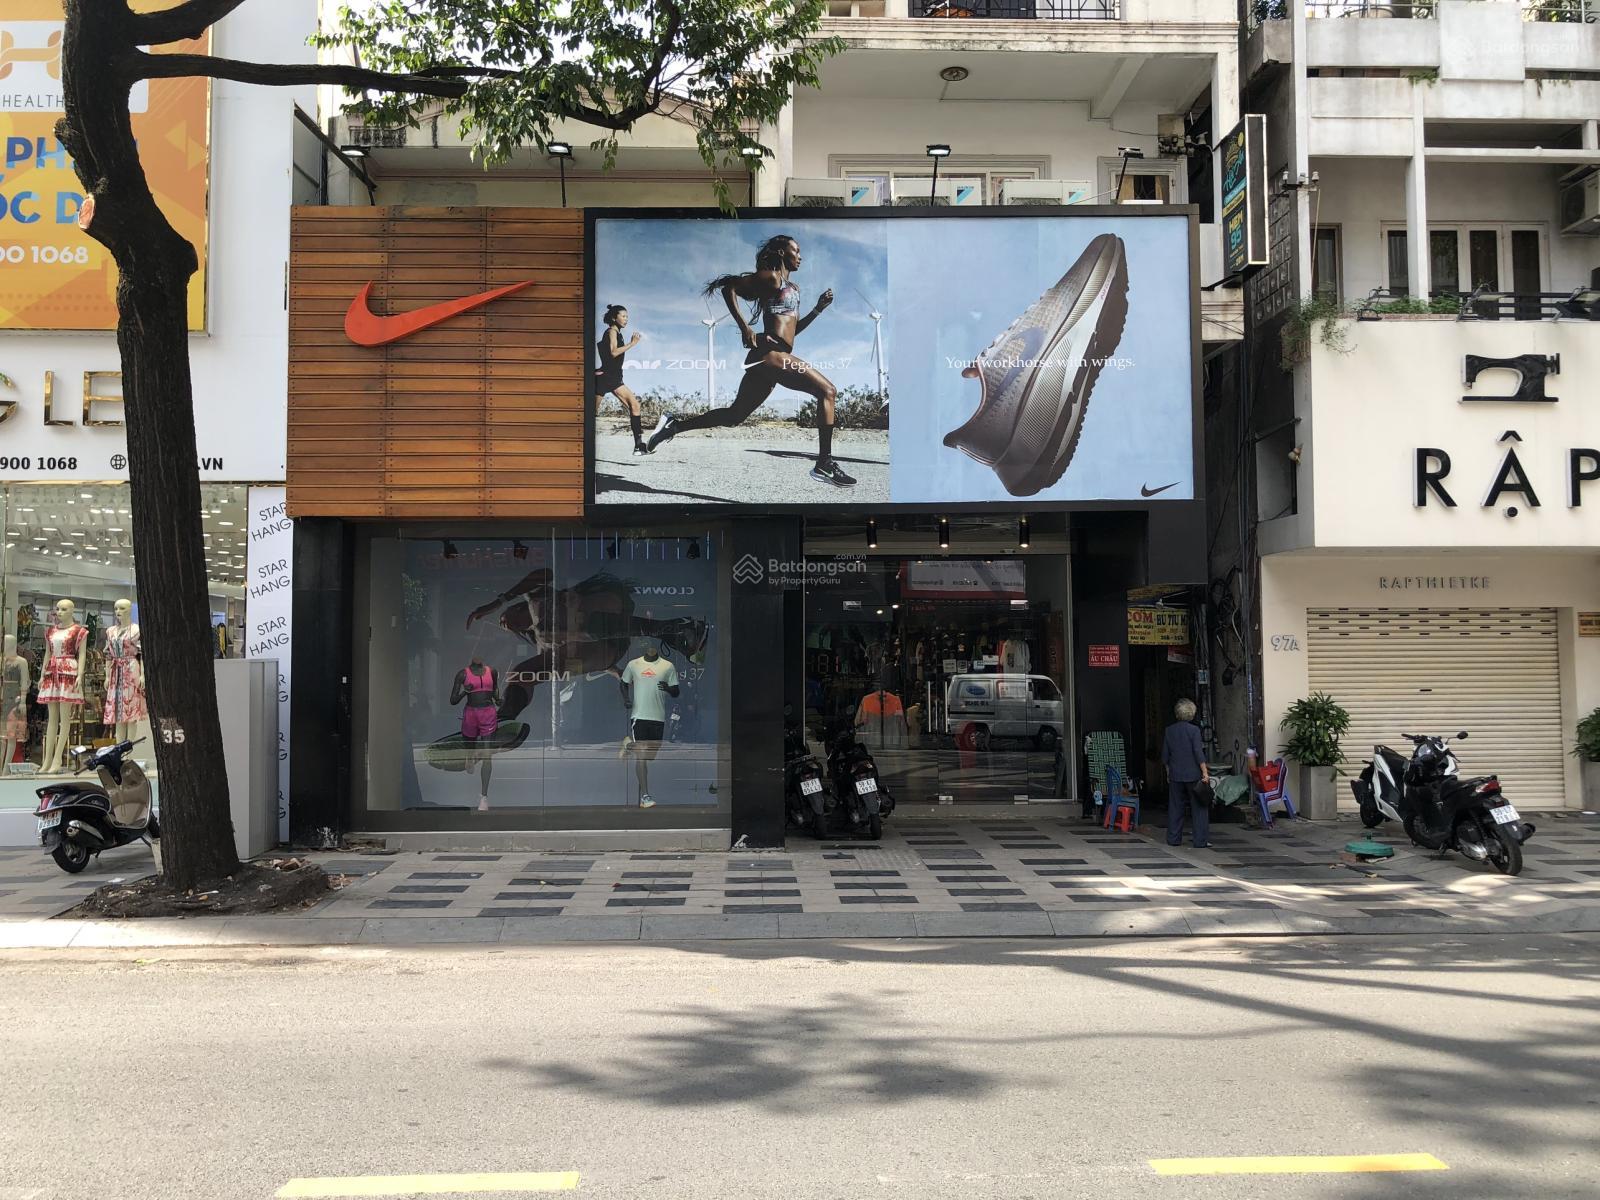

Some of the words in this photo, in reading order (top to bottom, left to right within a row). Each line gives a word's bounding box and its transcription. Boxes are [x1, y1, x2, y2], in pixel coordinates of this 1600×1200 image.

[31, 245, 89, 264] 1068
[665, 359, 727, 370] ZOOM
[782, 357, 835, 373] Pegasus
[837, 357, 853, 370] 37
[945, 356, 977, 369] Your
[980, 355, 1053, 369] workhorse
[1090, 355, 1136, 373] wings.
[37, 456, 78, 470] 1068
[1412, 430, 1600, 518] RẬP
[251, 518, 292, 542] HANG
[258, 559, 288, 579] STAR
[250, 575, 291, 599] HANG
[1379, 576, 1491, 589] RAPTHIETKE
[256, 616, 287, 636] STAR
[249, 632, 290, 657] HANG
[1270, 635, 1299, 651] 97A
[505, 670, 570, 683] ZOOM
[163, 729, 185, 743] 35
